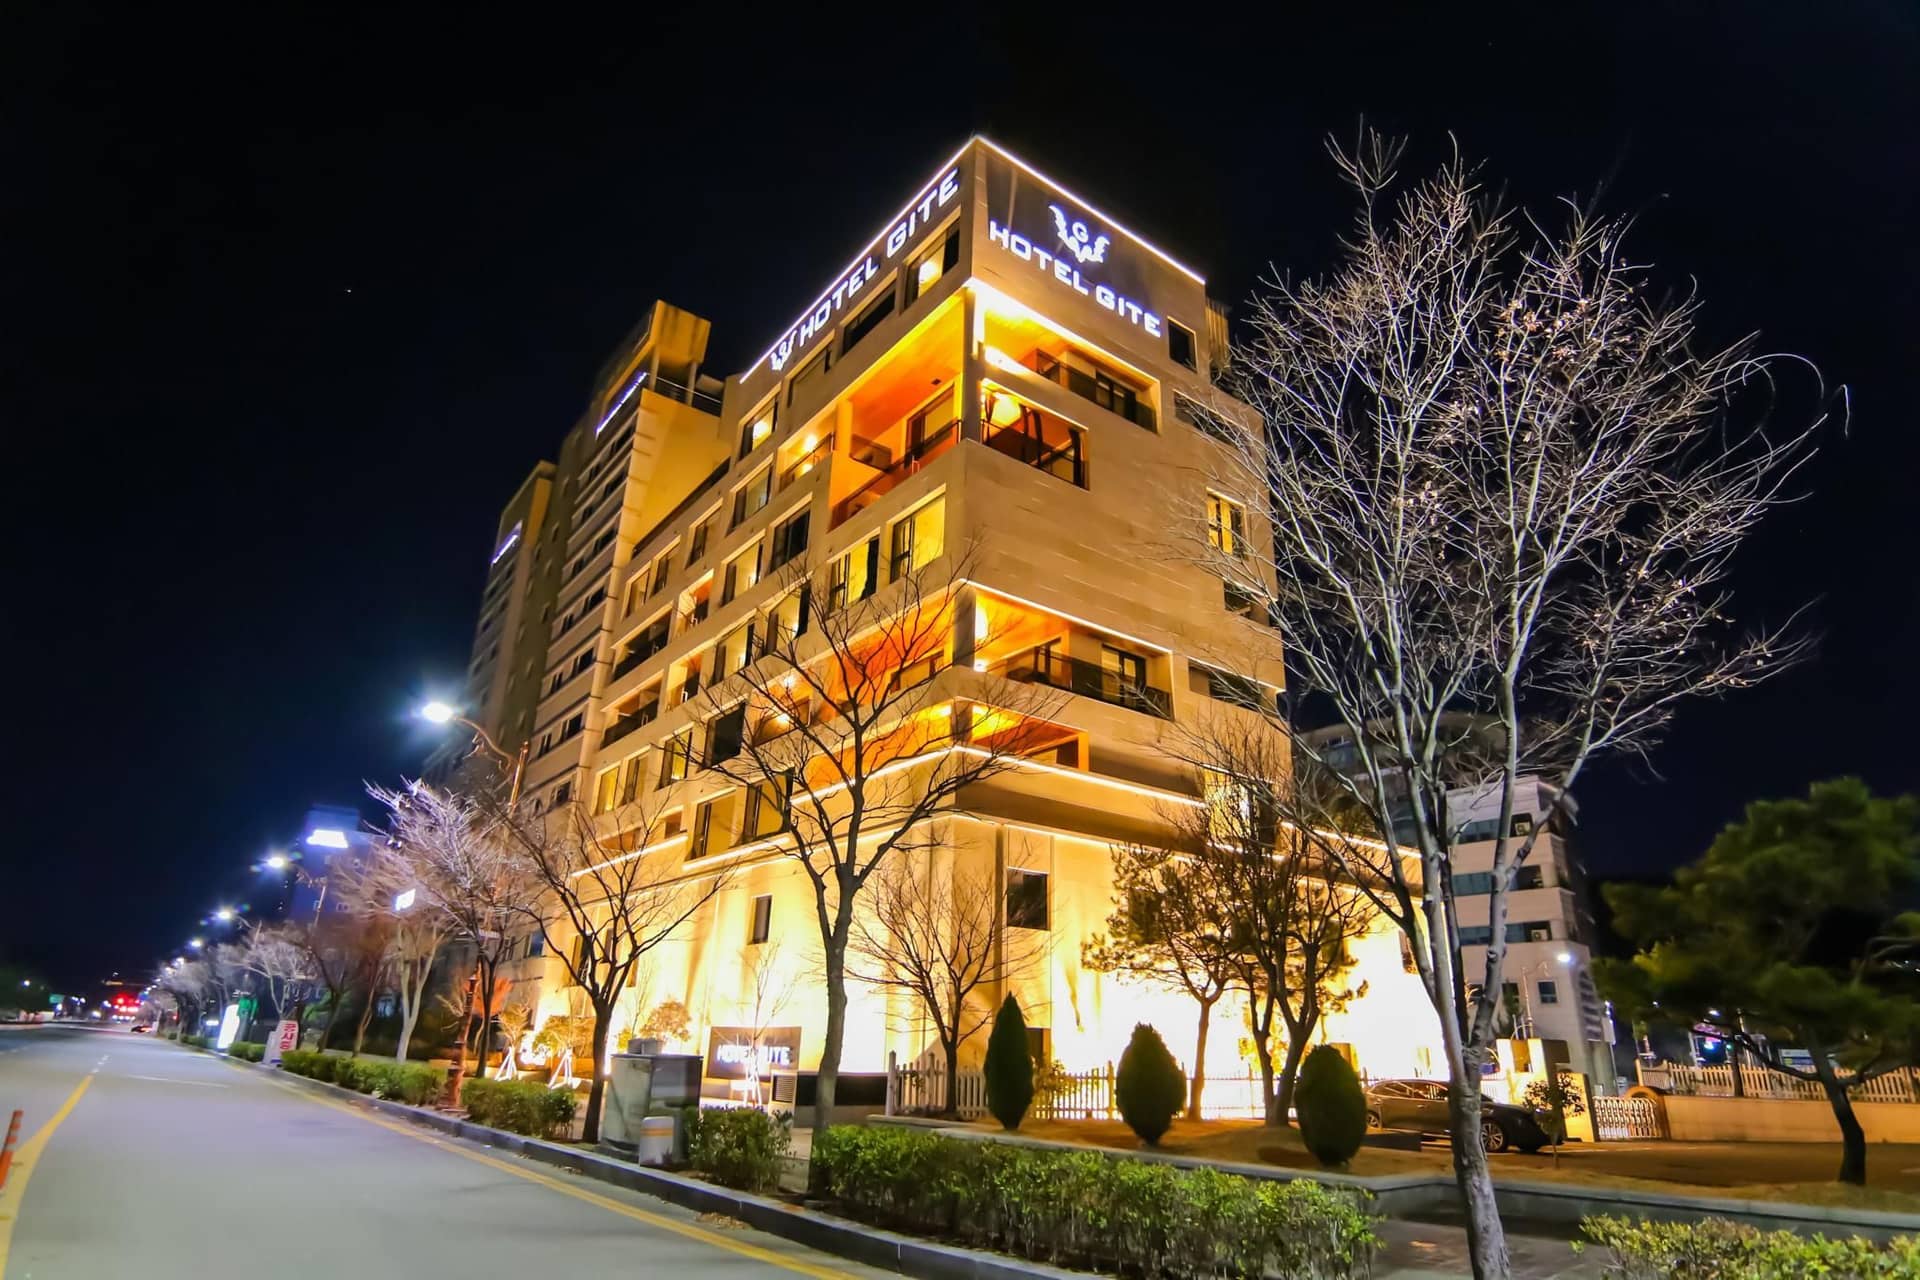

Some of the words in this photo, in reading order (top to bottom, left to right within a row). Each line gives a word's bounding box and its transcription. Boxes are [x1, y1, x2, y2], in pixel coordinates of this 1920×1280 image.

[800, 256, 880, 347] HOTEL
[886, 167, 959, 258] GITE
[989, 219, 1089, 296] HOTEL
[1095, 284, 1162, 338] GITE
[716, 1044, 756, 1064] HOTE
[758, 1046, 791, 1066] ITE
